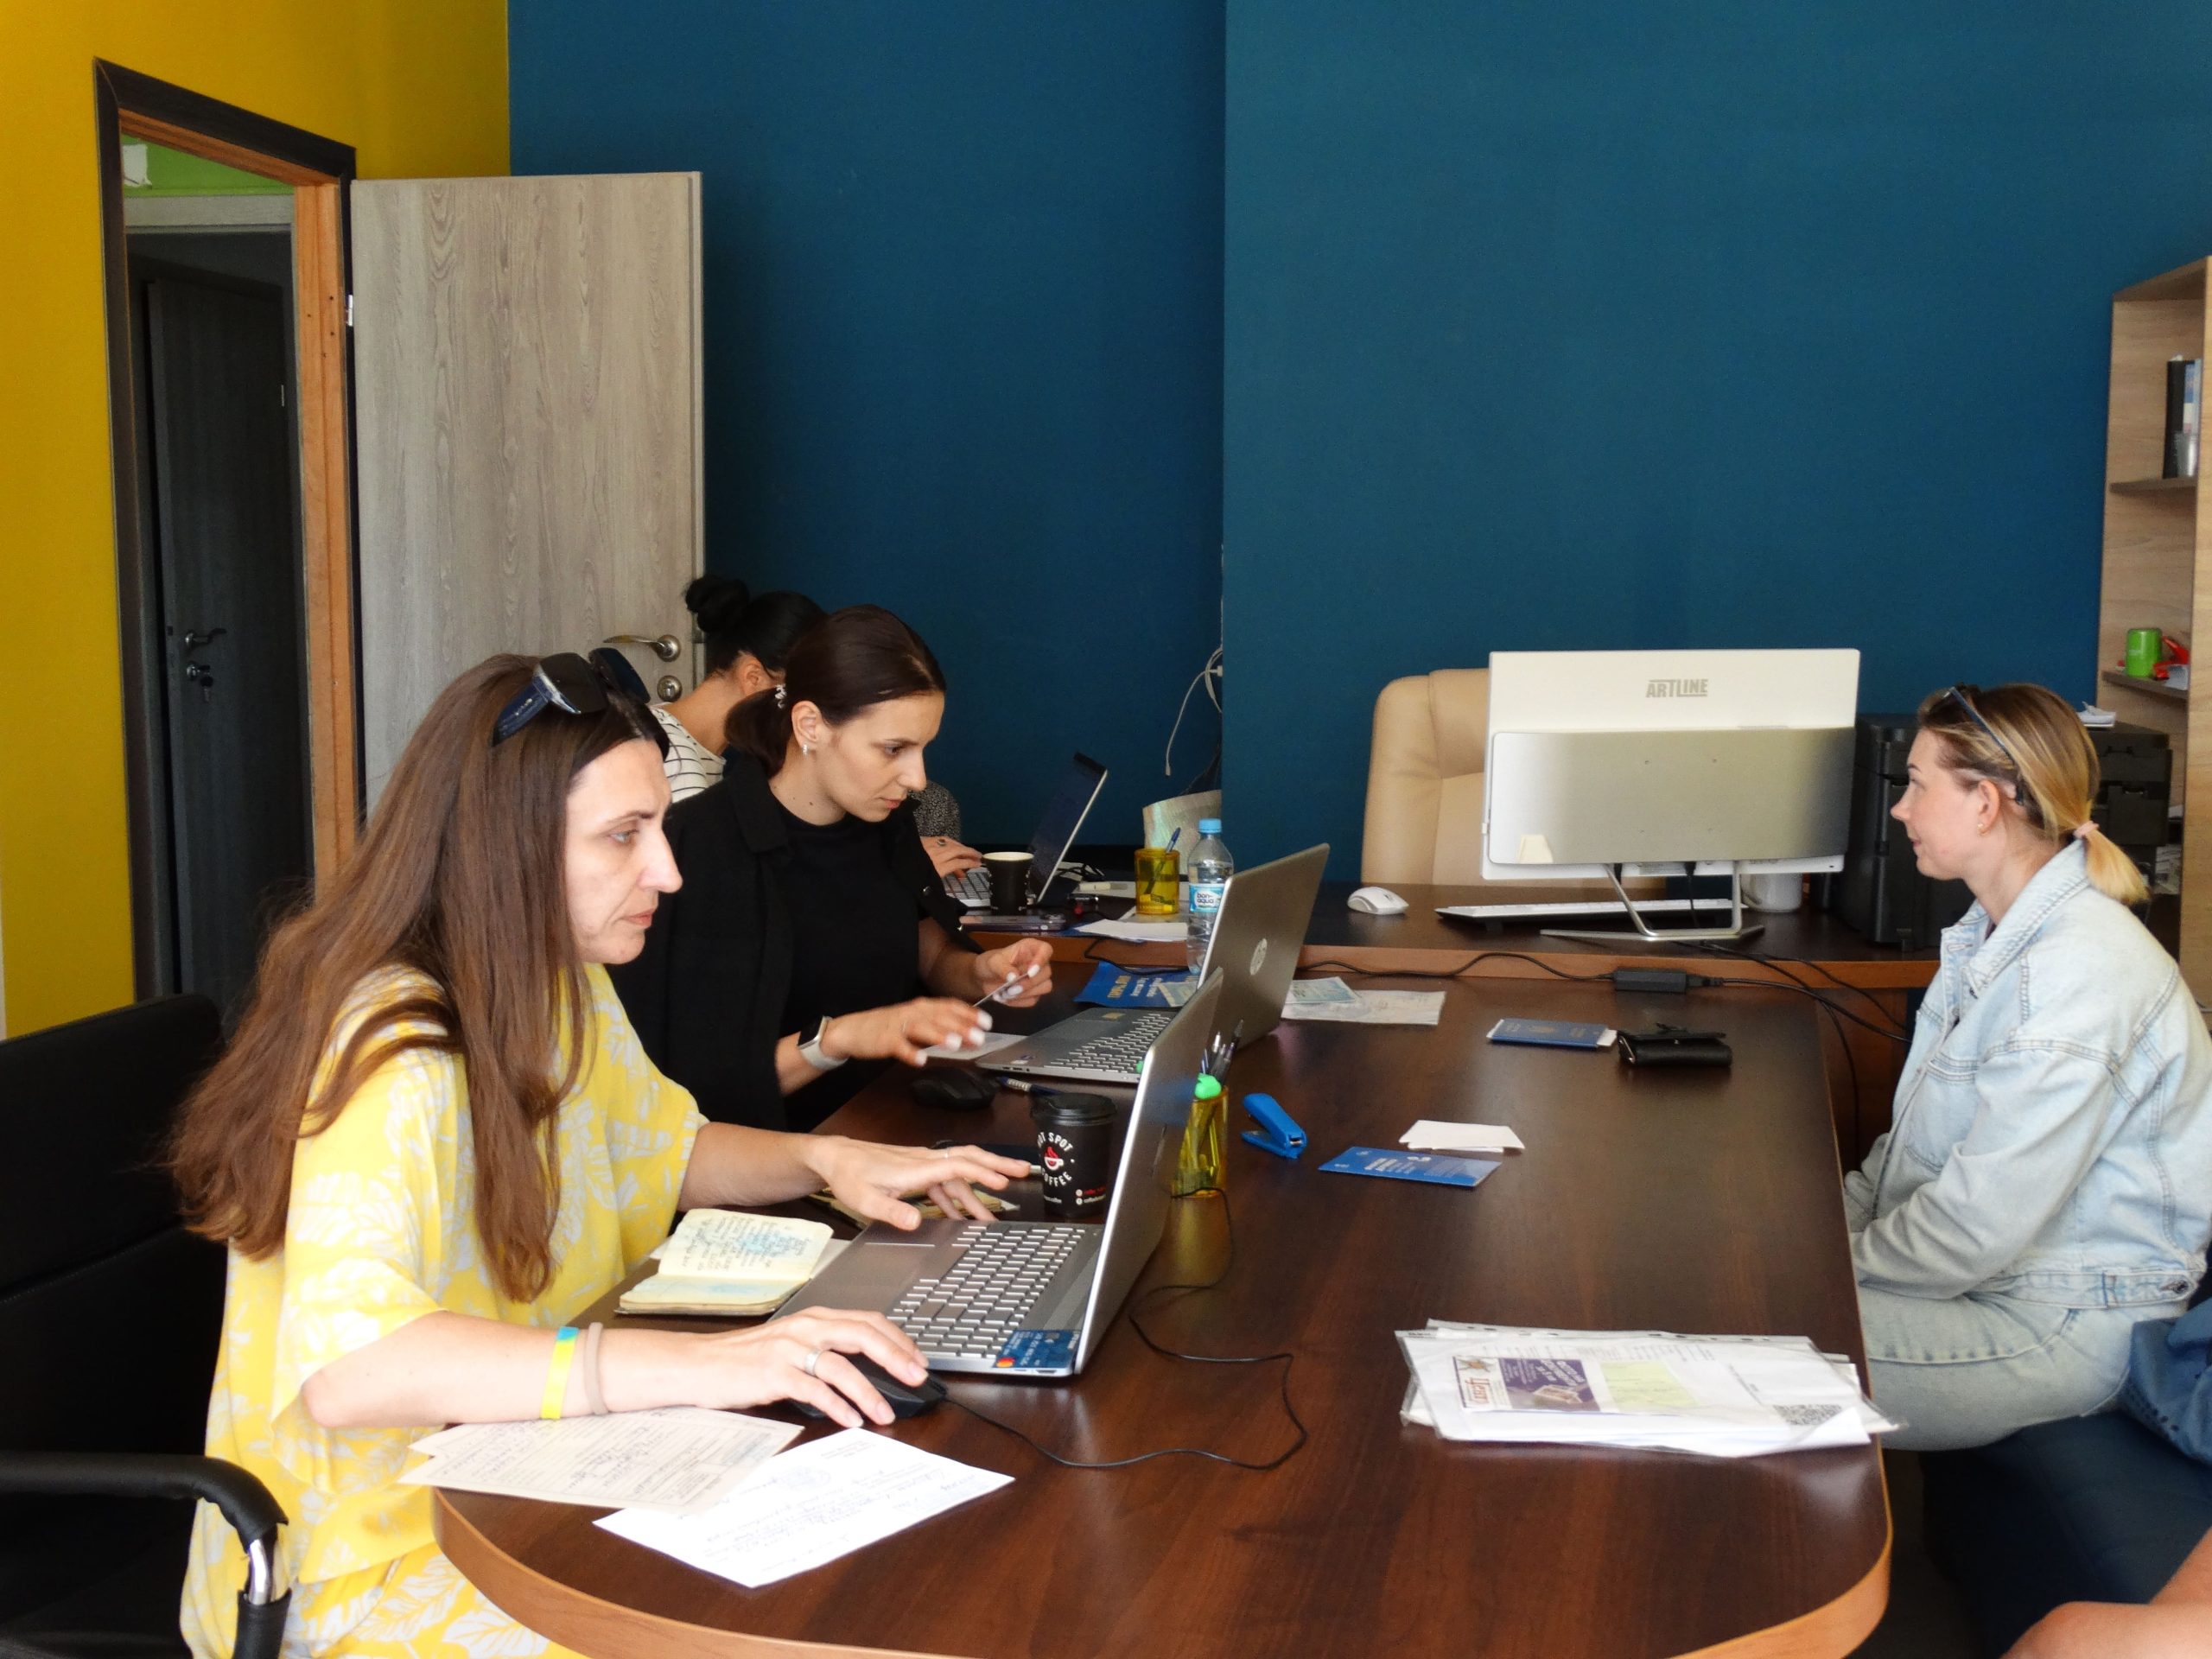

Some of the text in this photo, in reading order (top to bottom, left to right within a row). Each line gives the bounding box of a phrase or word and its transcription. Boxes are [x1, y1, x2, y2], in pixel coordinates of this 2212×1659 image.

[1645, 678, 1709, 697] ARTLINE
[1048, 1131, 1074, 1152] SPOT
[1041, 1167, 1072, 1187] COFFEE
